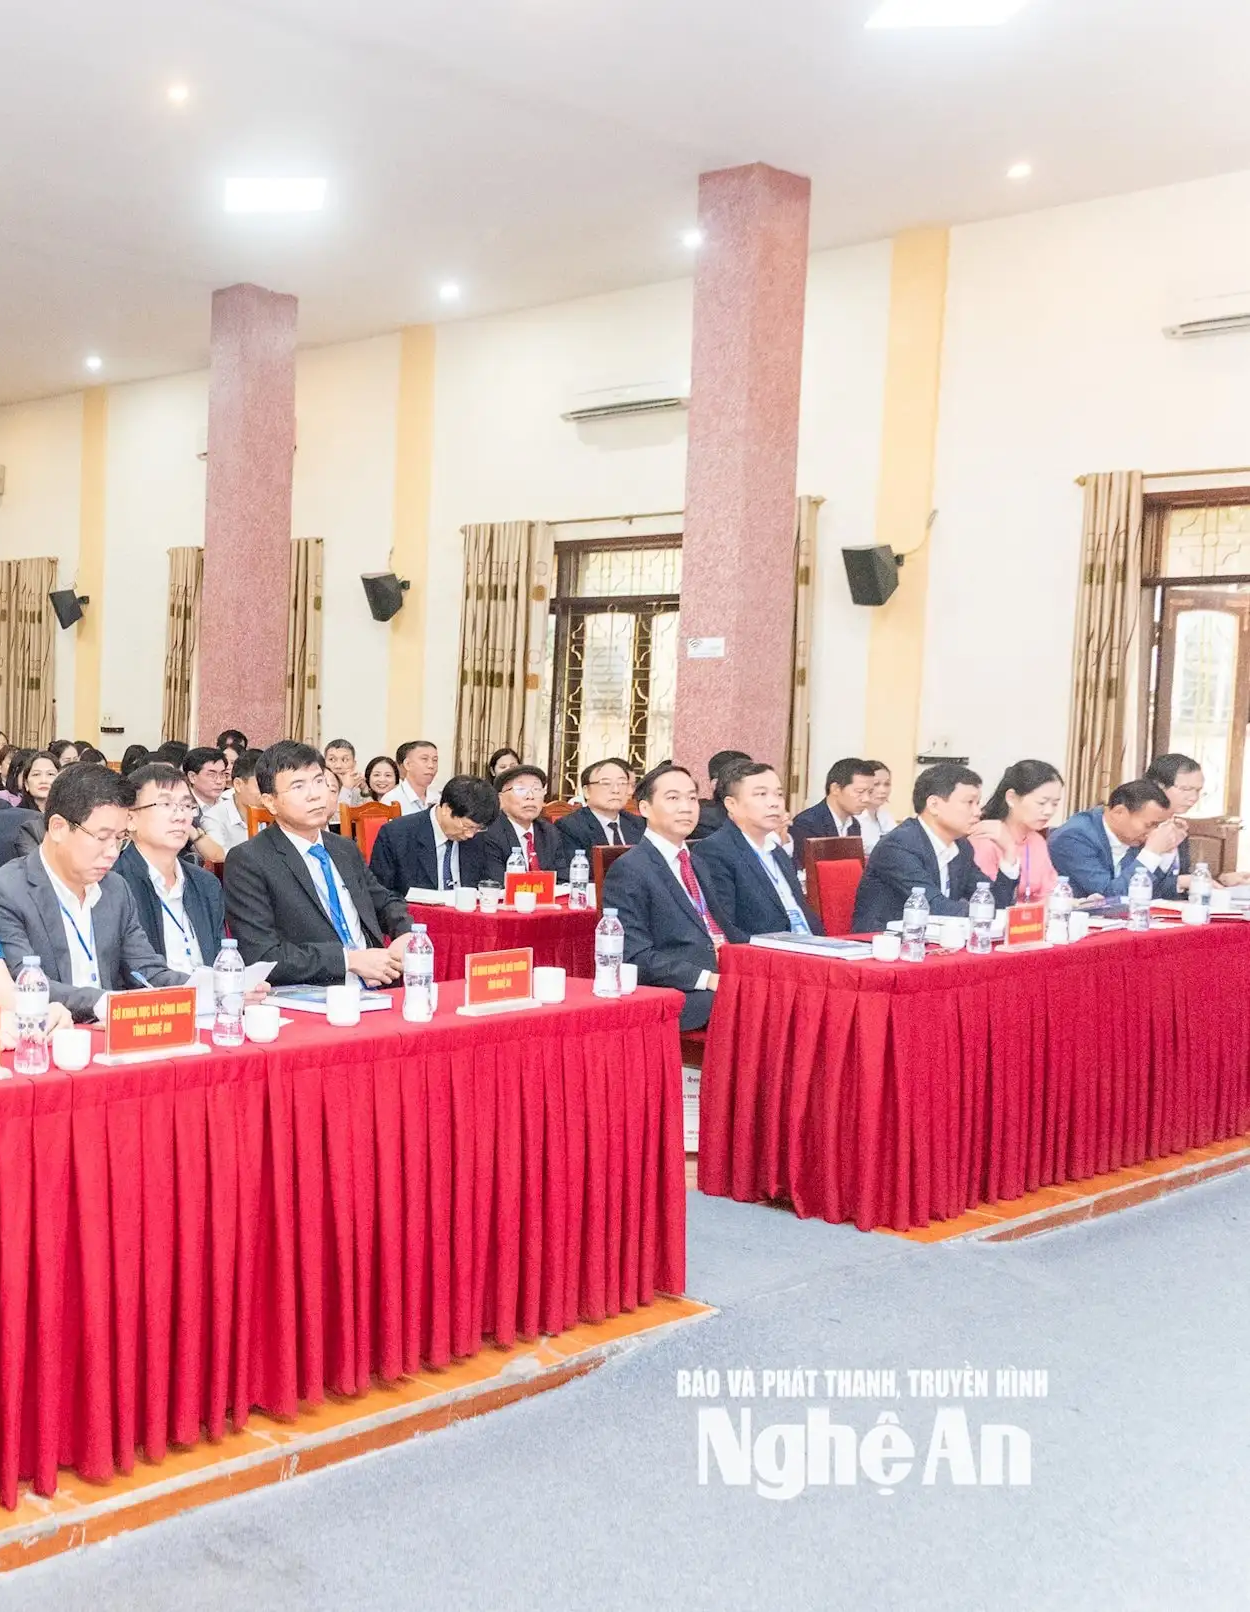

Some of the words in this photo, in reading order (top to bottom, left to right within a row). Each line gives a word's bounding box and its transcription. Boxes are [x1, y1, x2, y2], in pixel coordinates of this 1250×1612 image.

[151, 1000, 160, 1017] VÀ
[160, 1002, 176, 1016] CÔNG
[147, 1020, 163, 1036] NGHỆ
[163, 1020, 172, 1033] AN
